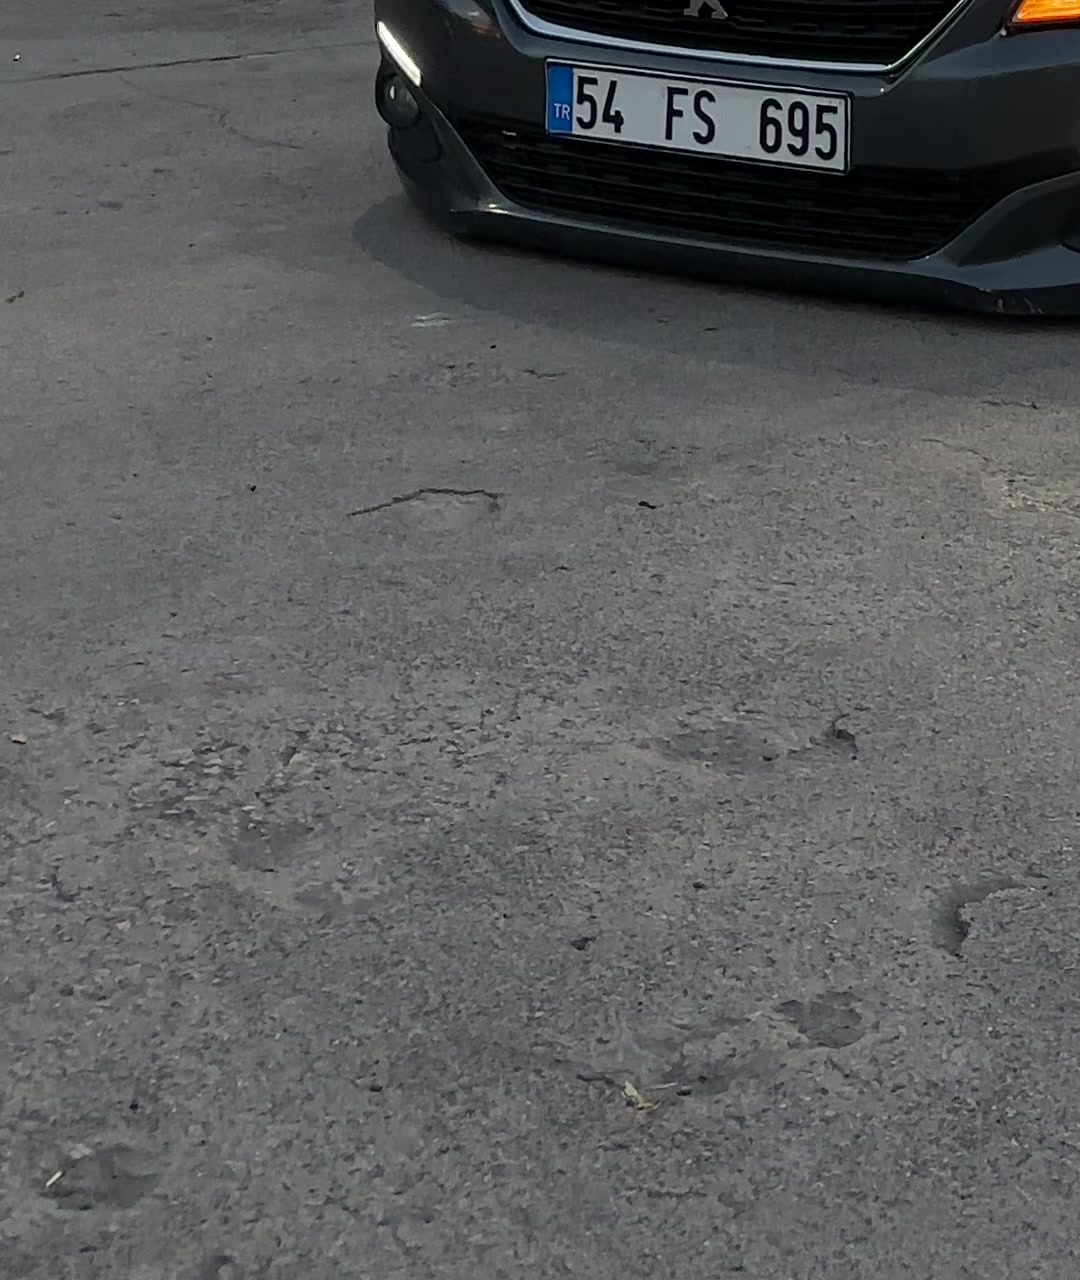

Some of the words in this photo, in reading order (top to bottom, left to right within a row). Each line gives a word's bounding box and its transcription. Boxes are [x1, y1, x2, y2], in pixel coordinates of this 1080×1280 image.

[553, 102, 572, 121] TR
[575, 75, 625, 134] 54
[664, 85, 717, 145] FS
[759, 97, 839, 161] 695
